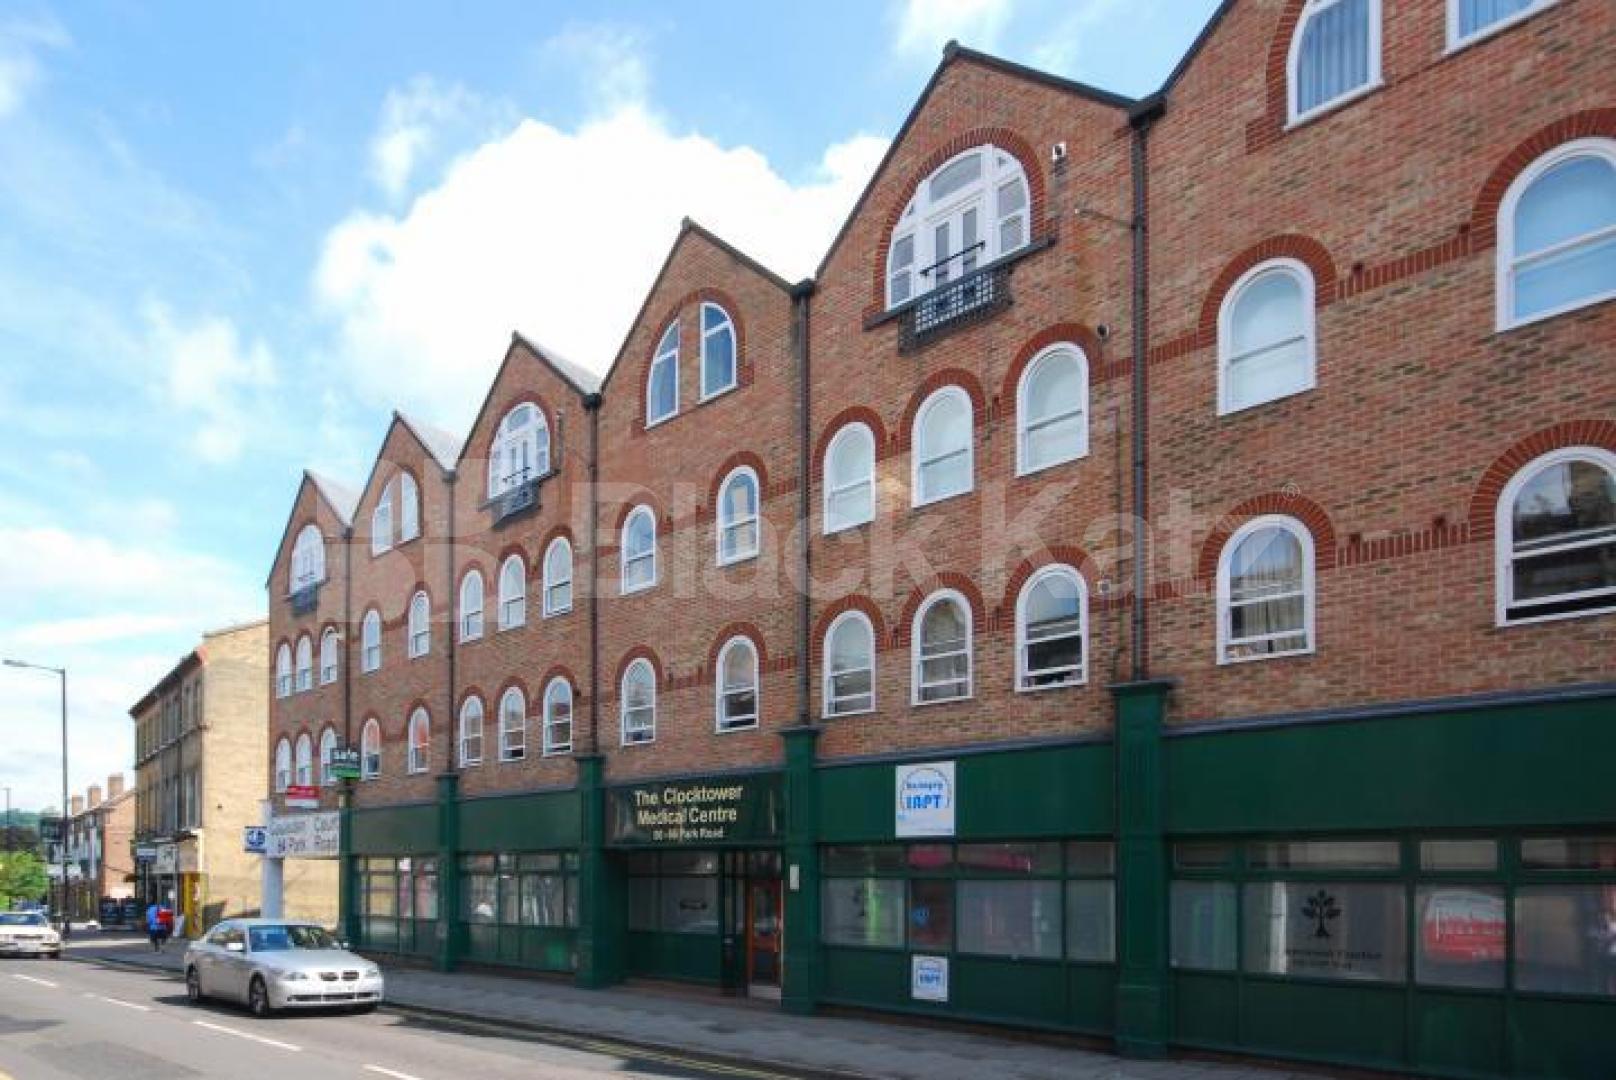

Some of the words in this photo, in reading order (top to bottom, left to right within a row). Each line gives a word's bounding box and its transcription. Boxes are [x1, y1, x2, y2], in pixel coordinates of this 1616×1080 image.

[634, 790, 658, 805] The
[664, 786, 744, 804] Clocktower
[637, 806, 687, 825] Medical
[689, 806, 737, 823] Centre
